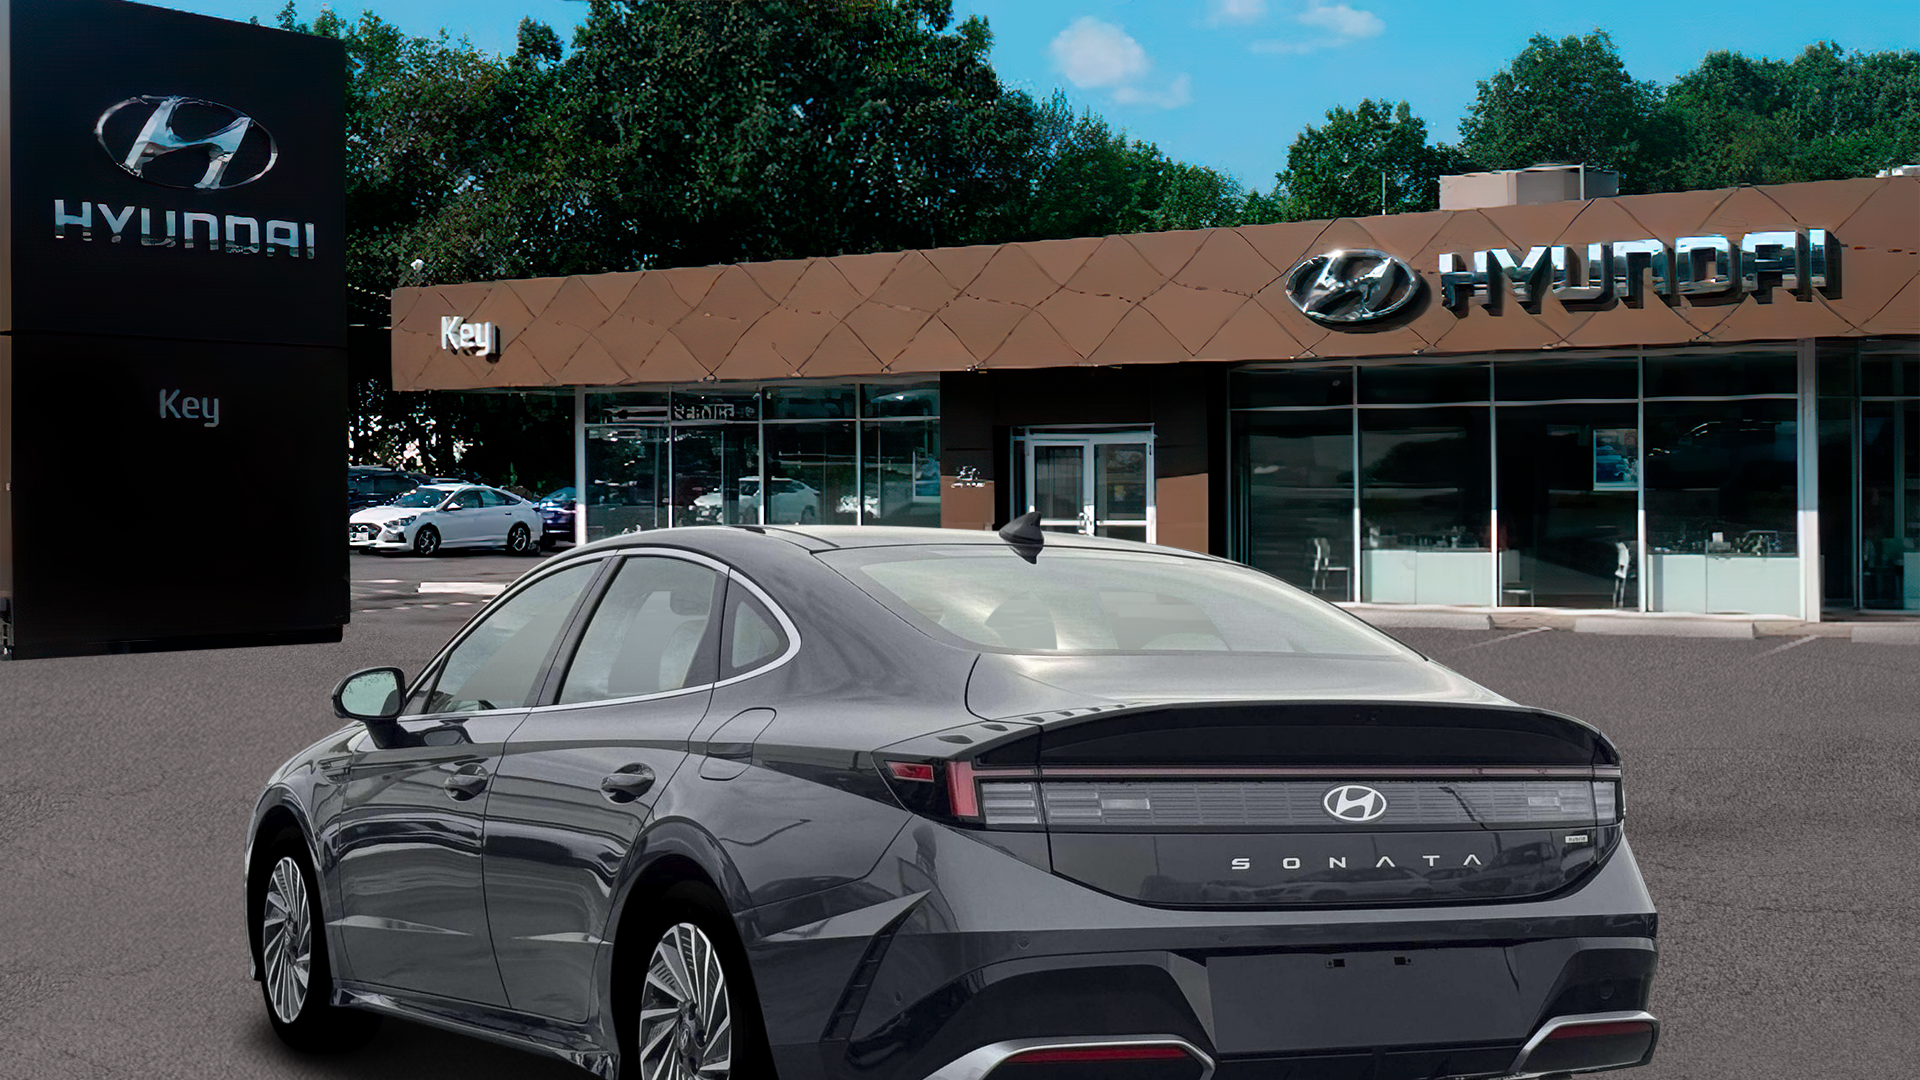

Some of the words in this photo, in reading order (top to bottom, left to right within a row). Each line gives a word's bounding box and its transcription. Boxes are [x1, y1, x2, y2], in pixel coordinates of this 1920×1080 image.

[54, 199, 315, 260] HYUNDAI
[1438, 228, 1838, 309] HYUNDAI
[440, 315, 493, 357] Key
[159, 388, 220, 428] Key
[1231, 853, 1483, 871] SONATA
